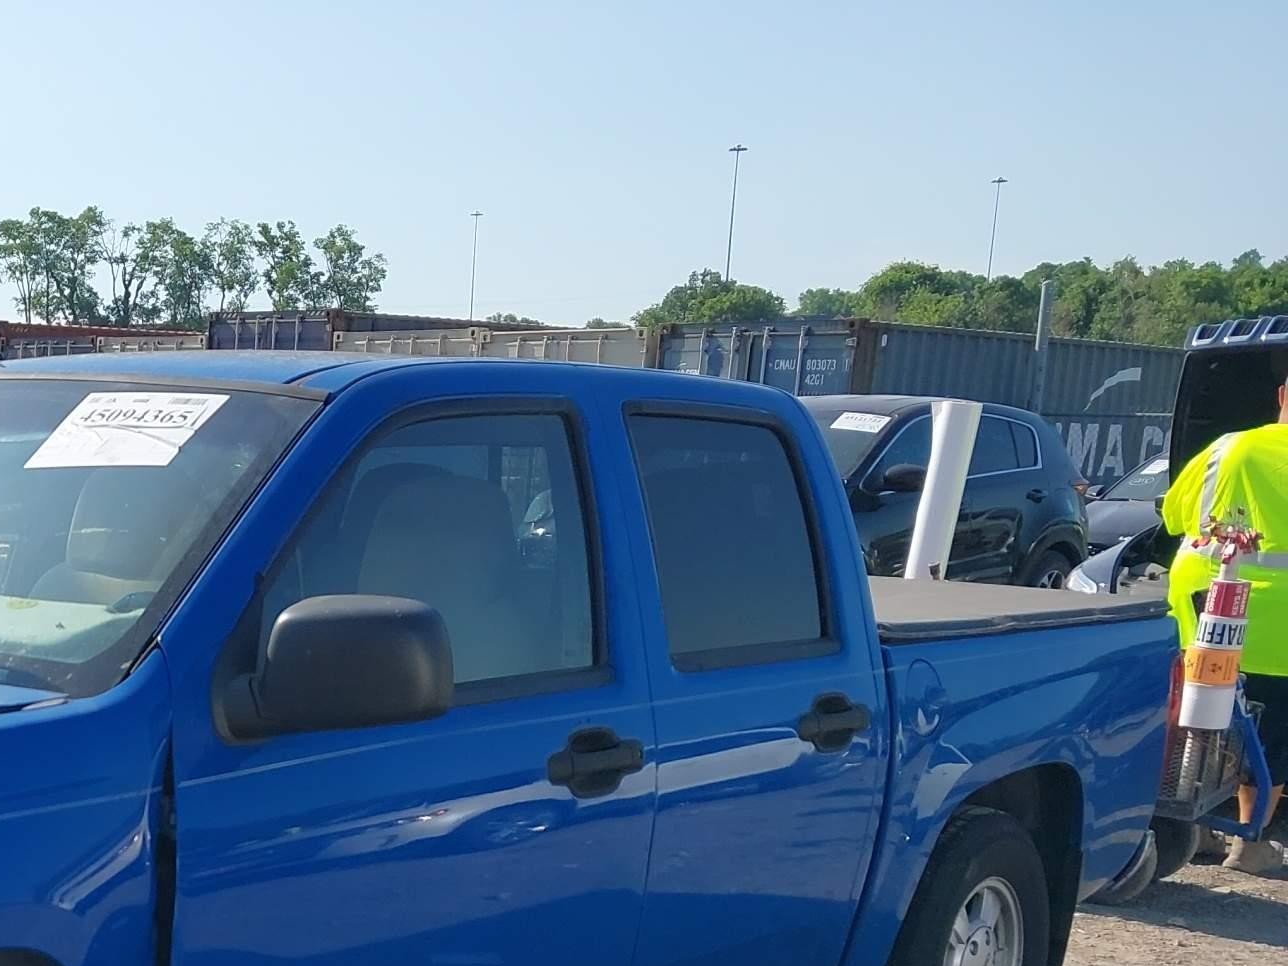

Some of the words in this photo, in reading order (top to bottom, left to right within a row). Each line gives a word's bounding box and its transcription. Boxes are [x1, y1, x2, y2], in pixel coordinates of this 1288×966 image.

[774, 359, 796, 370] CMAU
[805, 359, 837, 370] 803073
[80, 408, 194, 424] 45094365
[1056, 422, 1125, 477] MA
